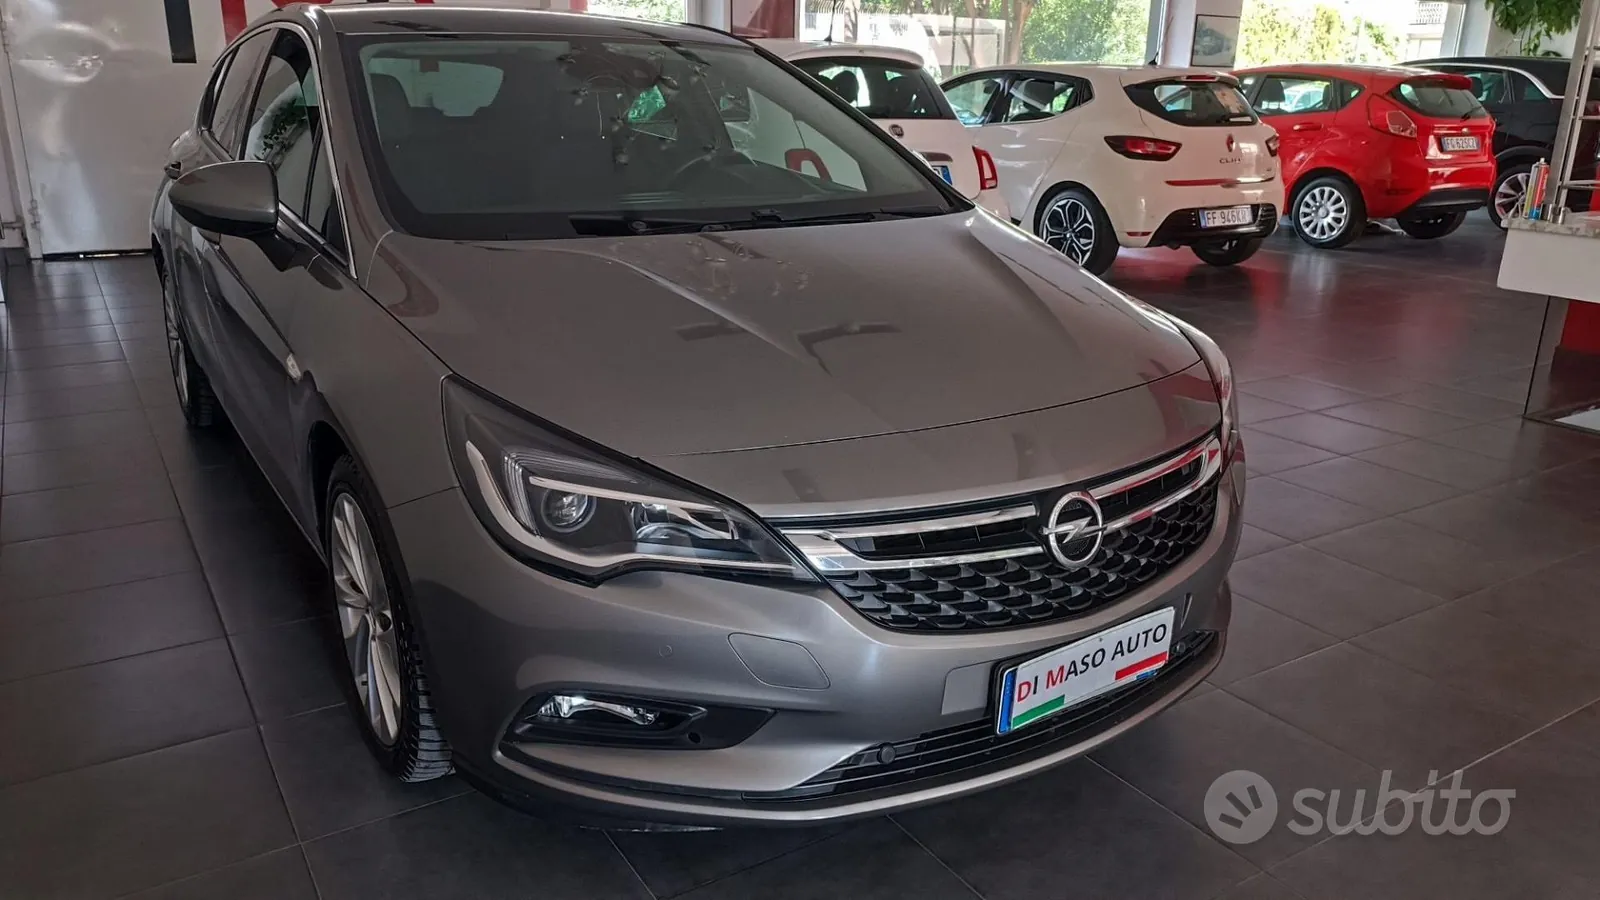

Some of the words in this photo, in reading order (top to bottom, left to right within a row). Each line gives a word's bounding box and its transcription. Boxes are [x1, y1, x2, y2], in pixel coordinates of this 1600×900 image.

[1206, 211, 1217, 225] FF
[1017, 675, 1038, 703] DI
[1045, 648, 1106, 690] MASO
[1111, 623, 1167, 661] AUTO
